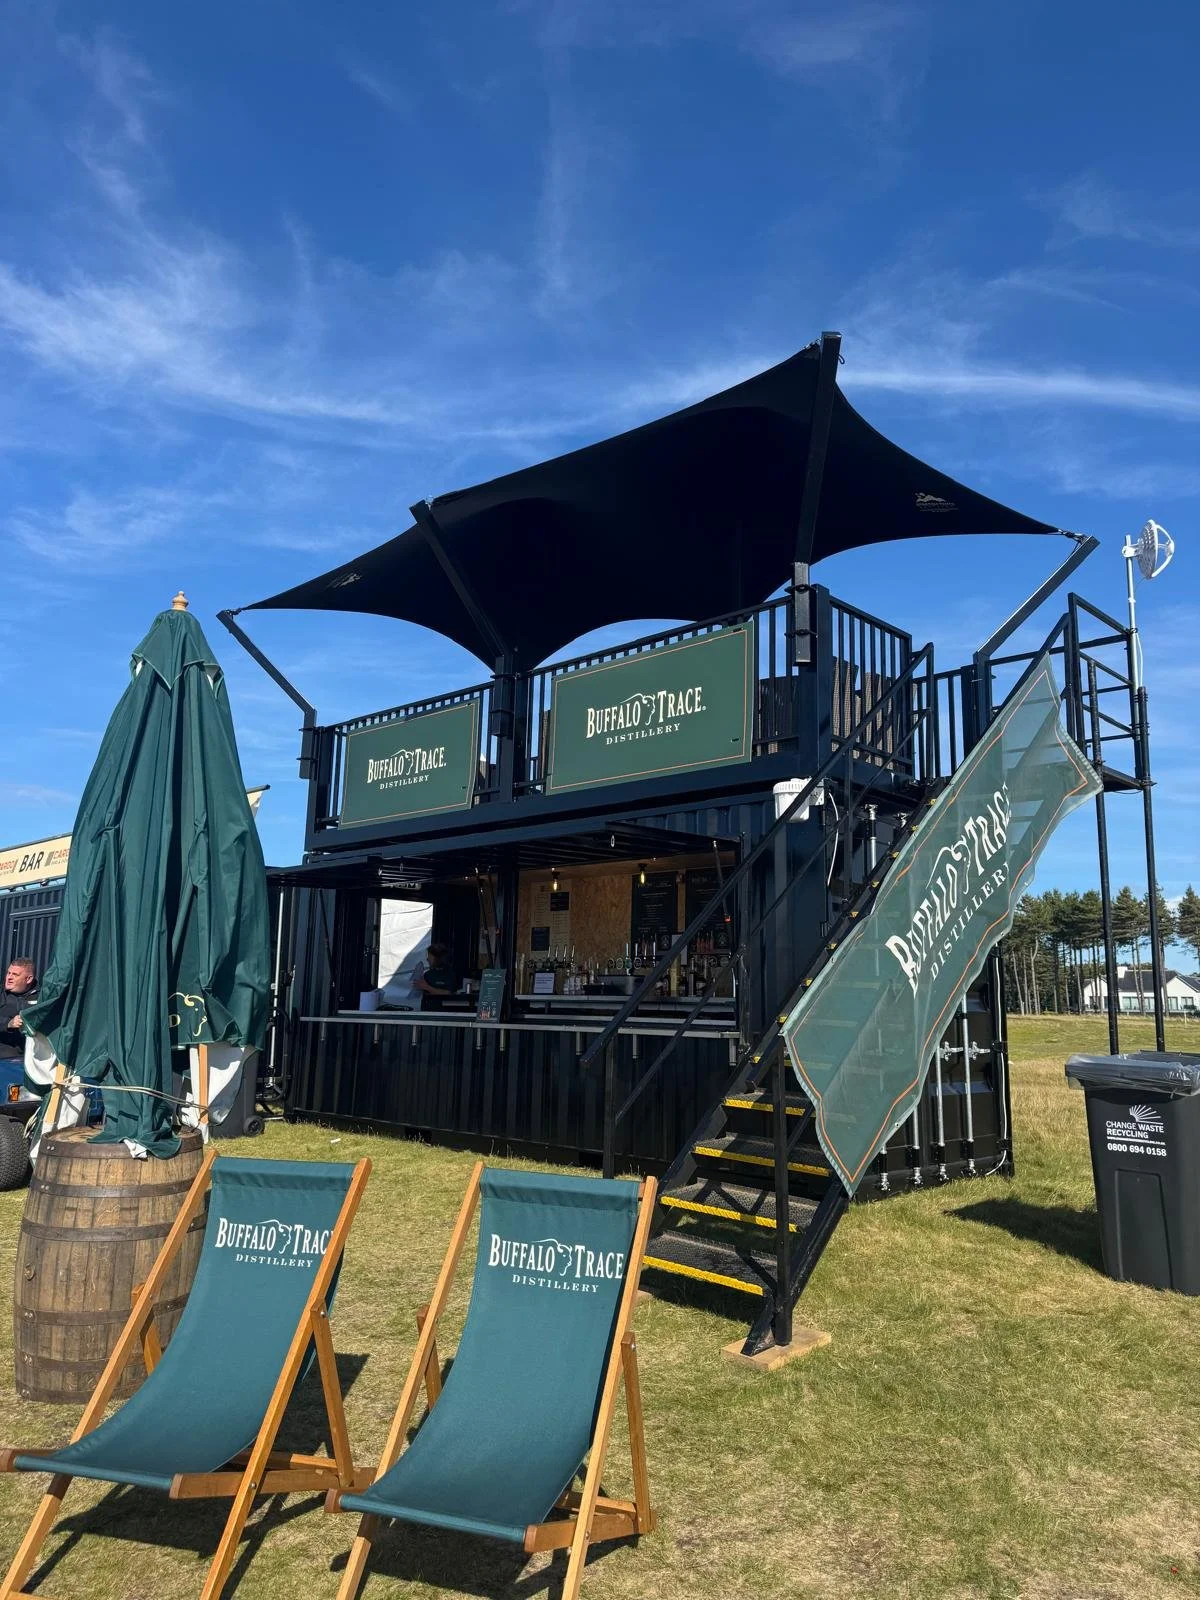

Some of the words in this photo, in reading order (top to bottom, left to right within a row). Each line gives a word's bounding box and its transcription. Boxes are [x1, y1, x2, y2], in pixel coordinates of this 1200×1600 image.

[585, 700, 641, 738] BUFFALO
[606, 723, 680, 745] DISTILLERY
[367, 755, 404, 784] BUFFALO
[379, 774, 429, 790] DISTILLERY
[19, 851, 44, 873] BAR
[1105, 1120, 1137, 1130] CHANGE
[1138, 1123, 1165, 1133] WASTE
[1106, 1128, 1149, 1139] RECYCLING
[1107, 1142, 1128, 1152] 0800
[1129, 1145, 1145, 1154] 694
[1146, 1147, 1167, 1157] 0158
[214, 1217, 277, 1252] BUFFALO
[292, 1224, 334, 1256] TRAC
[235, 1253, 313, 1268] DISTILLERY
[487, 1233, 556, 1273] BUFFALO
[574, 1244, 625, 1279] TRACE
[512, 1274, 599, 1293] DISTILLERY
